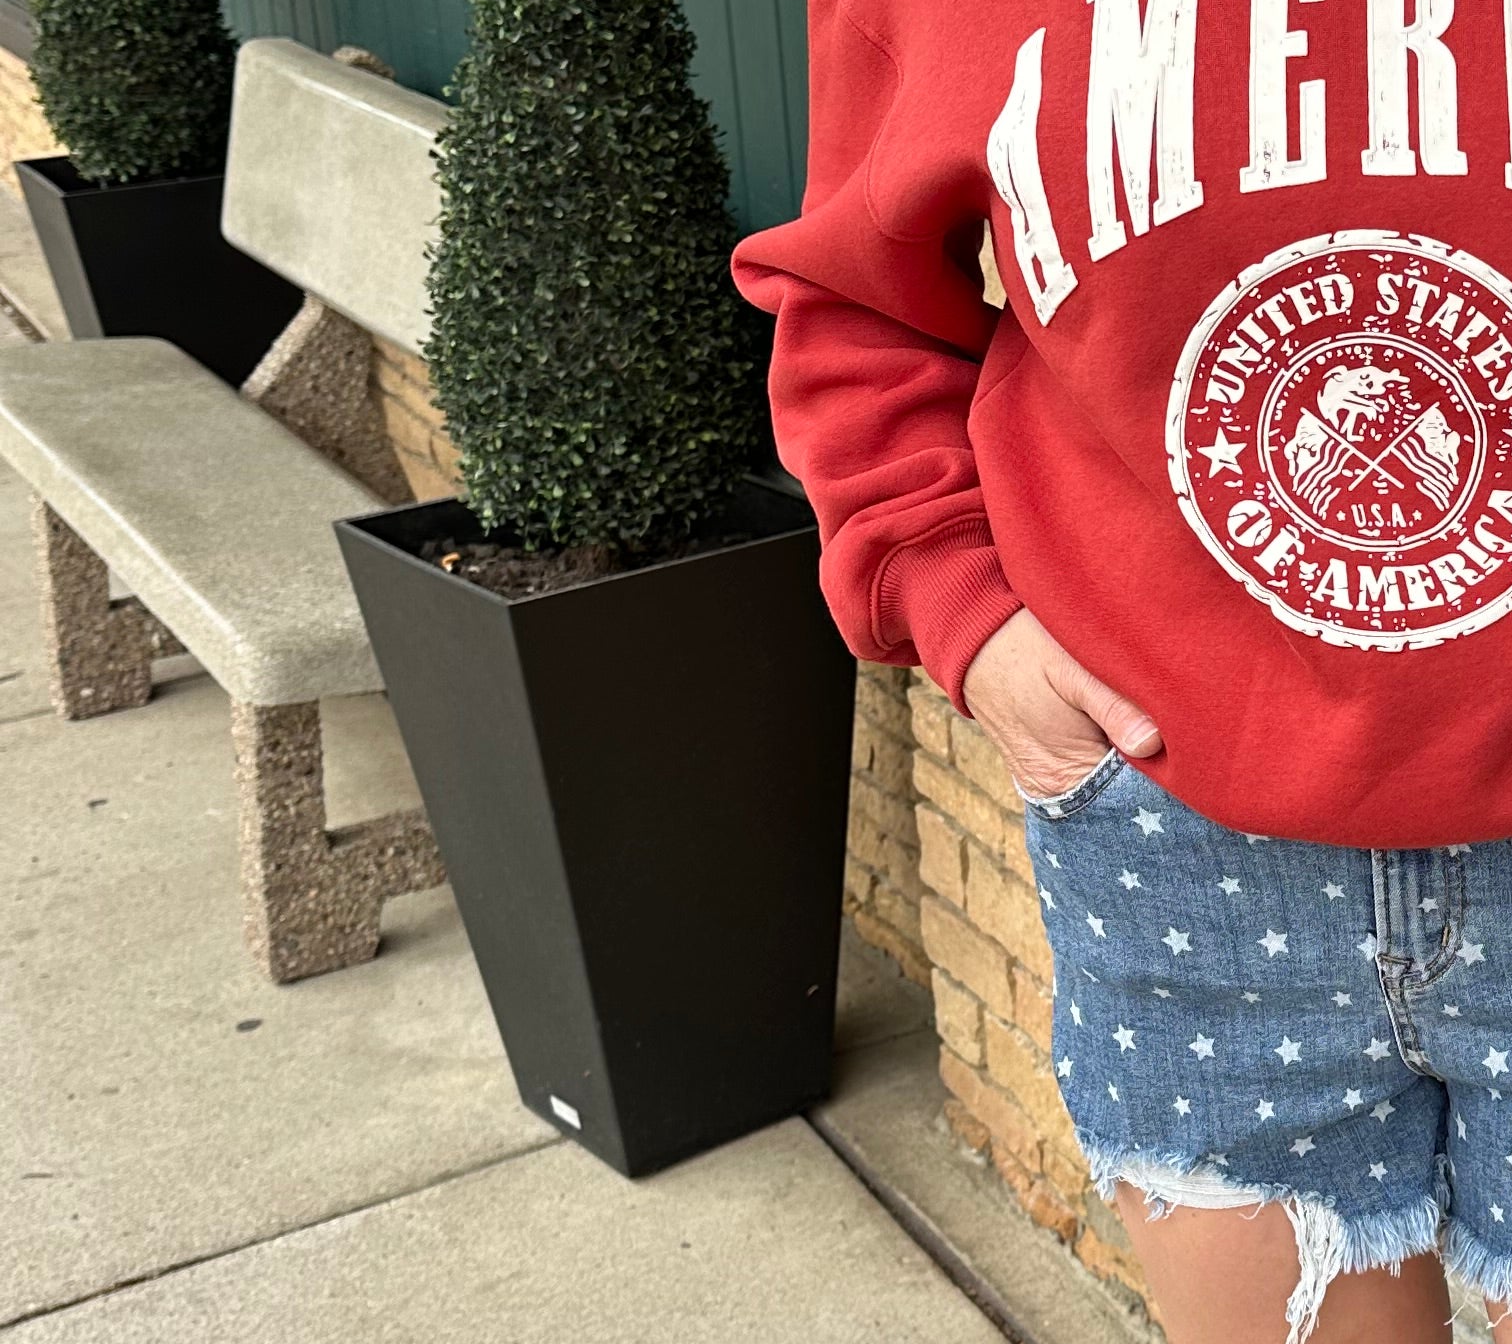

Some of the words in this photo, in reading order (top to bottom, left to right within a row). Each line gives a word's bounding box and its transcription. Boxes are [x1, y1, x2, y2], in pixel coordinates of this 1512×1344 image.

[1205, 273, 1355, 405] UNITED
[1226, 499, 1306, 577] OF
[1351, 503, 1414, 528] U.S.A.
